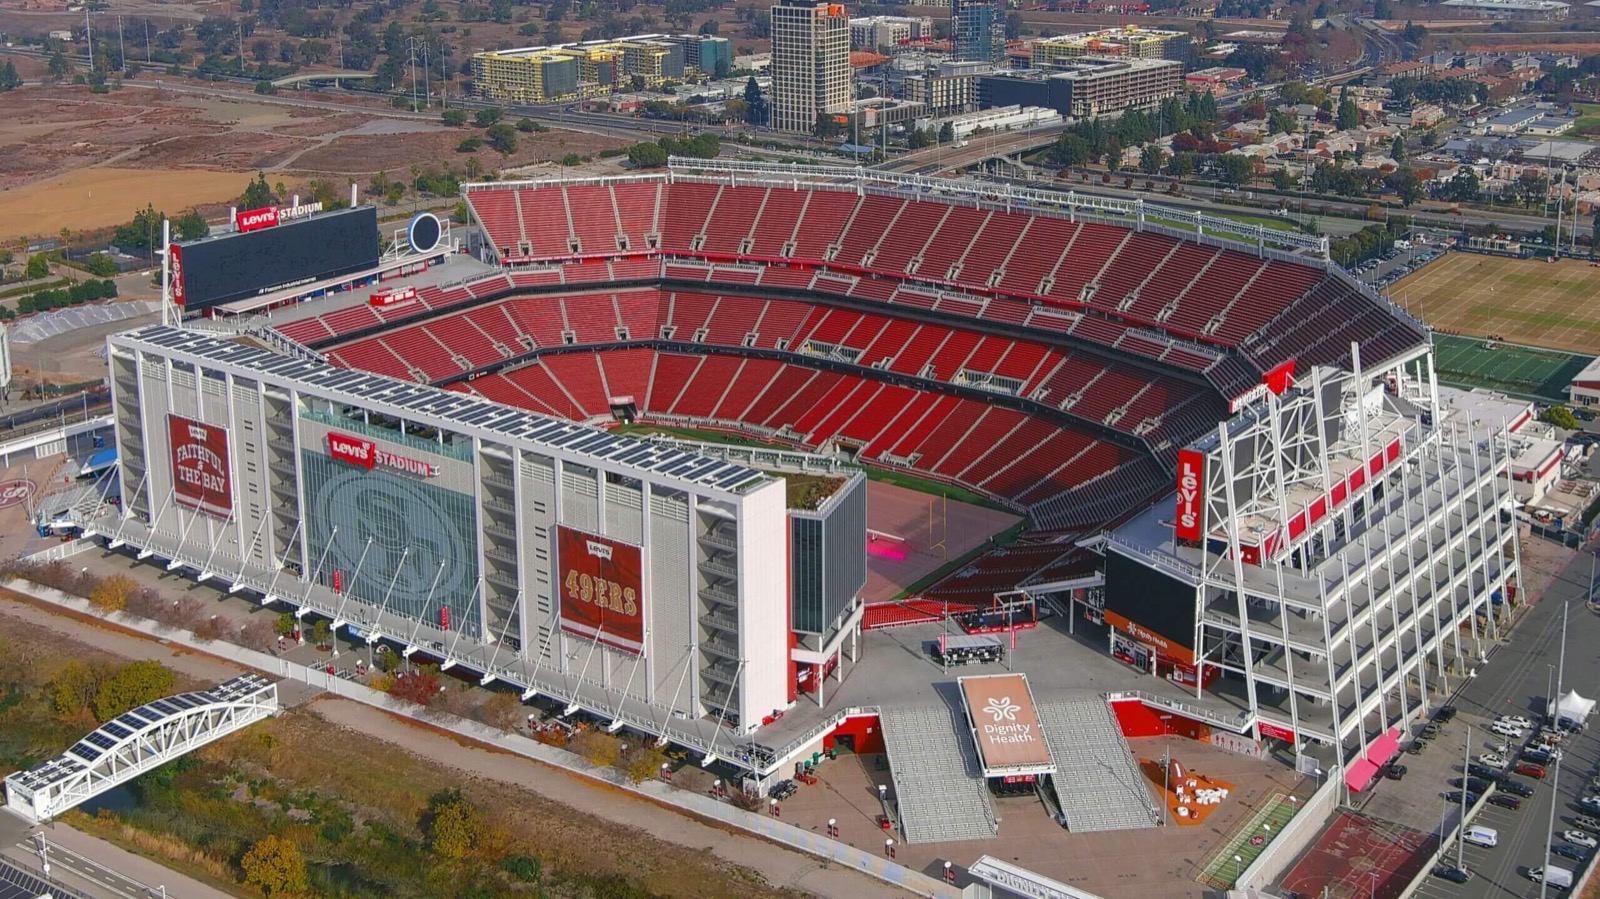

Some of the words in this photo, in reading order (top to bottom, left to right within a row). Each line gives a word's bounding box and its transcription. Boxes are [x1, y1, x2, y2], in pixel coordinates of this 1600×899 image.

[280, 202, 323, 218] STADIUM
[177, 443, 225, 477] FAITHFUL
[375, 450, 428, 476] STADIUM
[178, 464, 201, 486] THE
[202, 472, 225, 493] BAY
[1181, 462, 1197, 528] Levi's
[565, 569, 637, 616] 49ERS
[984, 723, 1030, 735] Dignity
[997, 870, 1052, 899] DIGNITY
